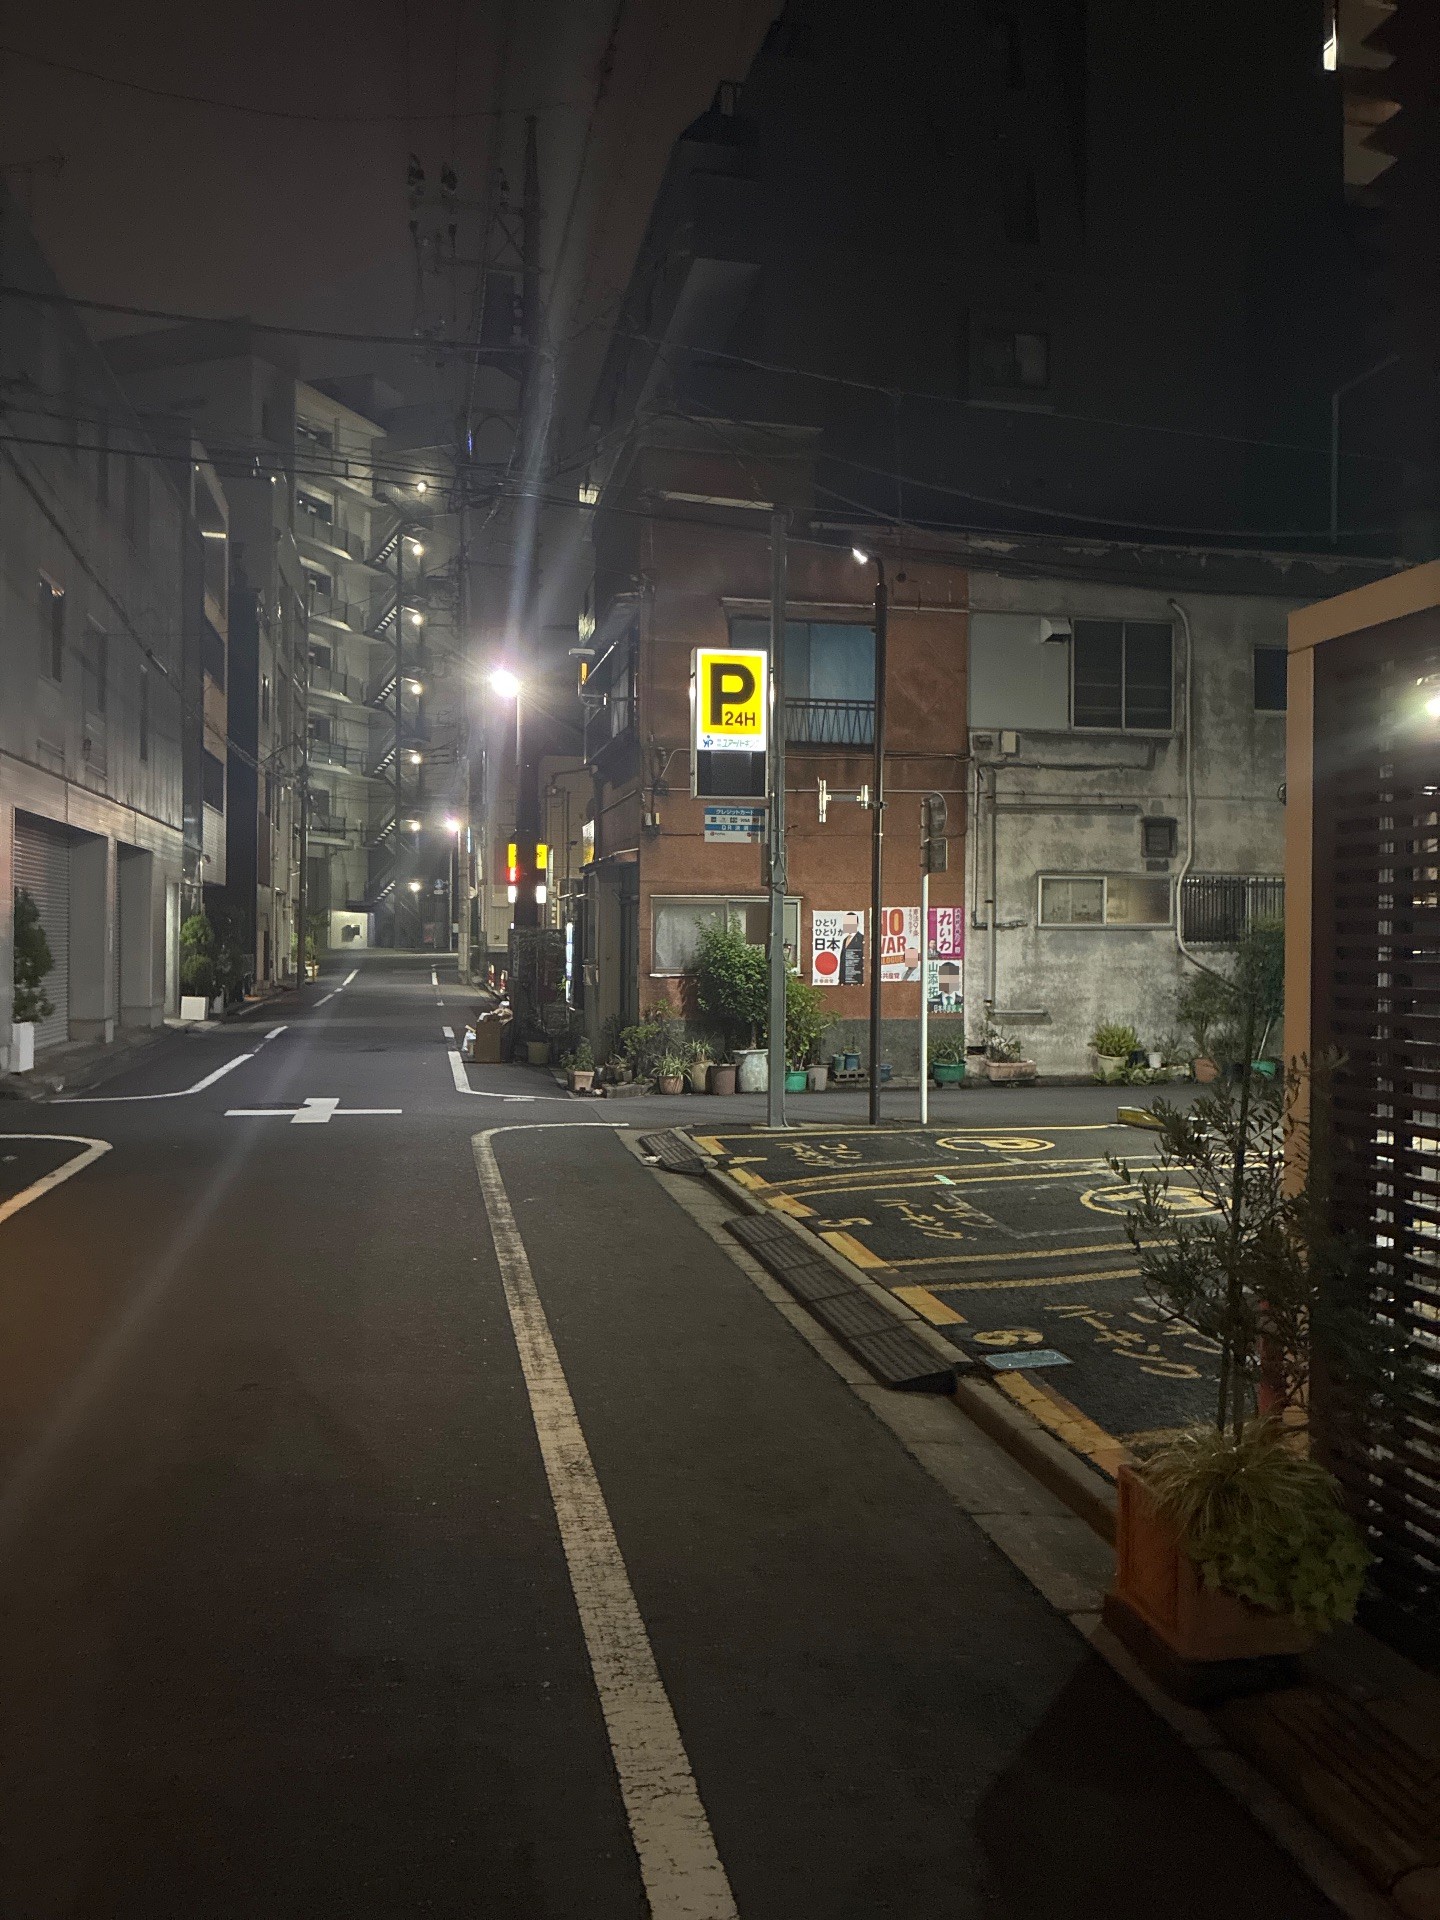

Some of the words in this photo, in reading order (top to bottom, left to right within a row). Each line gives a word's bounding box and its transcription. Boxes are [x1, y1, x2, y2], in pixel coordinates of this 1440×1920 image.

[710, 663, 755, 726] P
[724, 710, 756, 727] 24H
[815, 919, 837, 927] ひとり
[937, 910, 953, 952] れいわ
[815, 938, 840, 951] 日本
[928, 962, 938, 998] 山添拓
[816, 1217, 873, 1228] 5
[874, 1199, 977, 1241] パーキング
[972, 1329, 1045, 1346] 6
